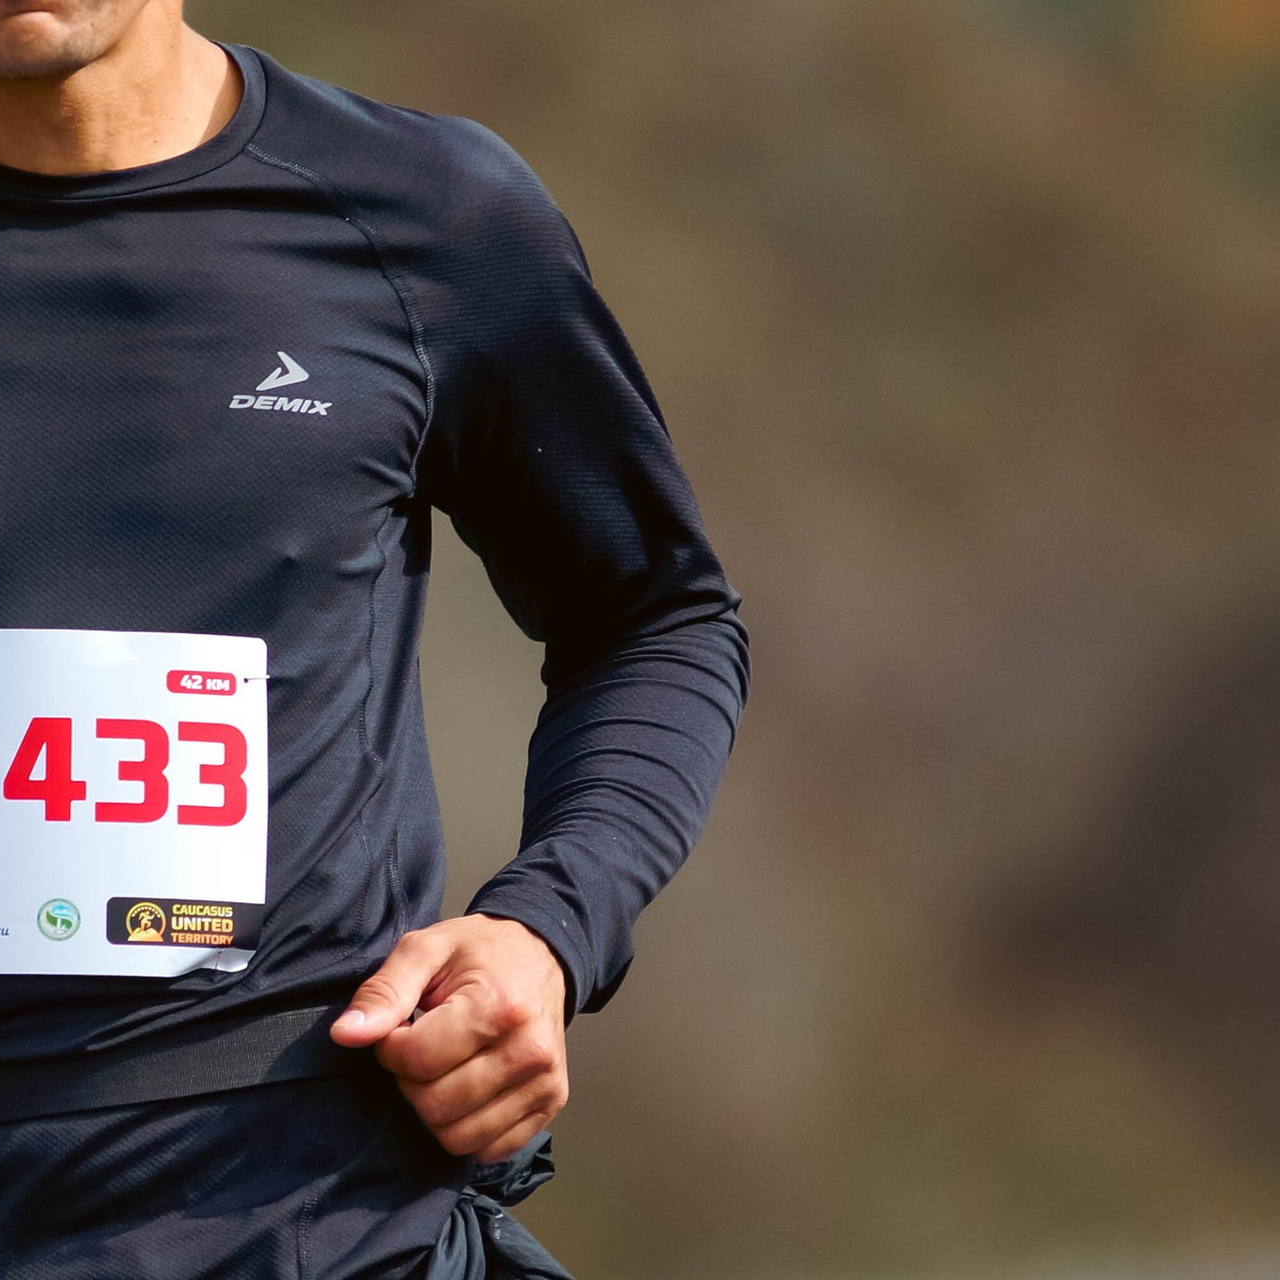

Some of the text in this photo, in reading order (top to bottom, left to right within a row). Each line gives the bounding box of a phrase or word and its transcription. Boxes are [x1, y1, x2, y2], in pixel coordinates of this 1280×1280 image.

[229, 394, 333, 416] DEMIX
[180, 674, 203, 690] 42
[2, 717, 248, 827] 433
[172, 904, 234, 917] CAUCASUS
[171, 917, 234, 933] UNITED
[170, 932, 234, 945] TERRITORY
